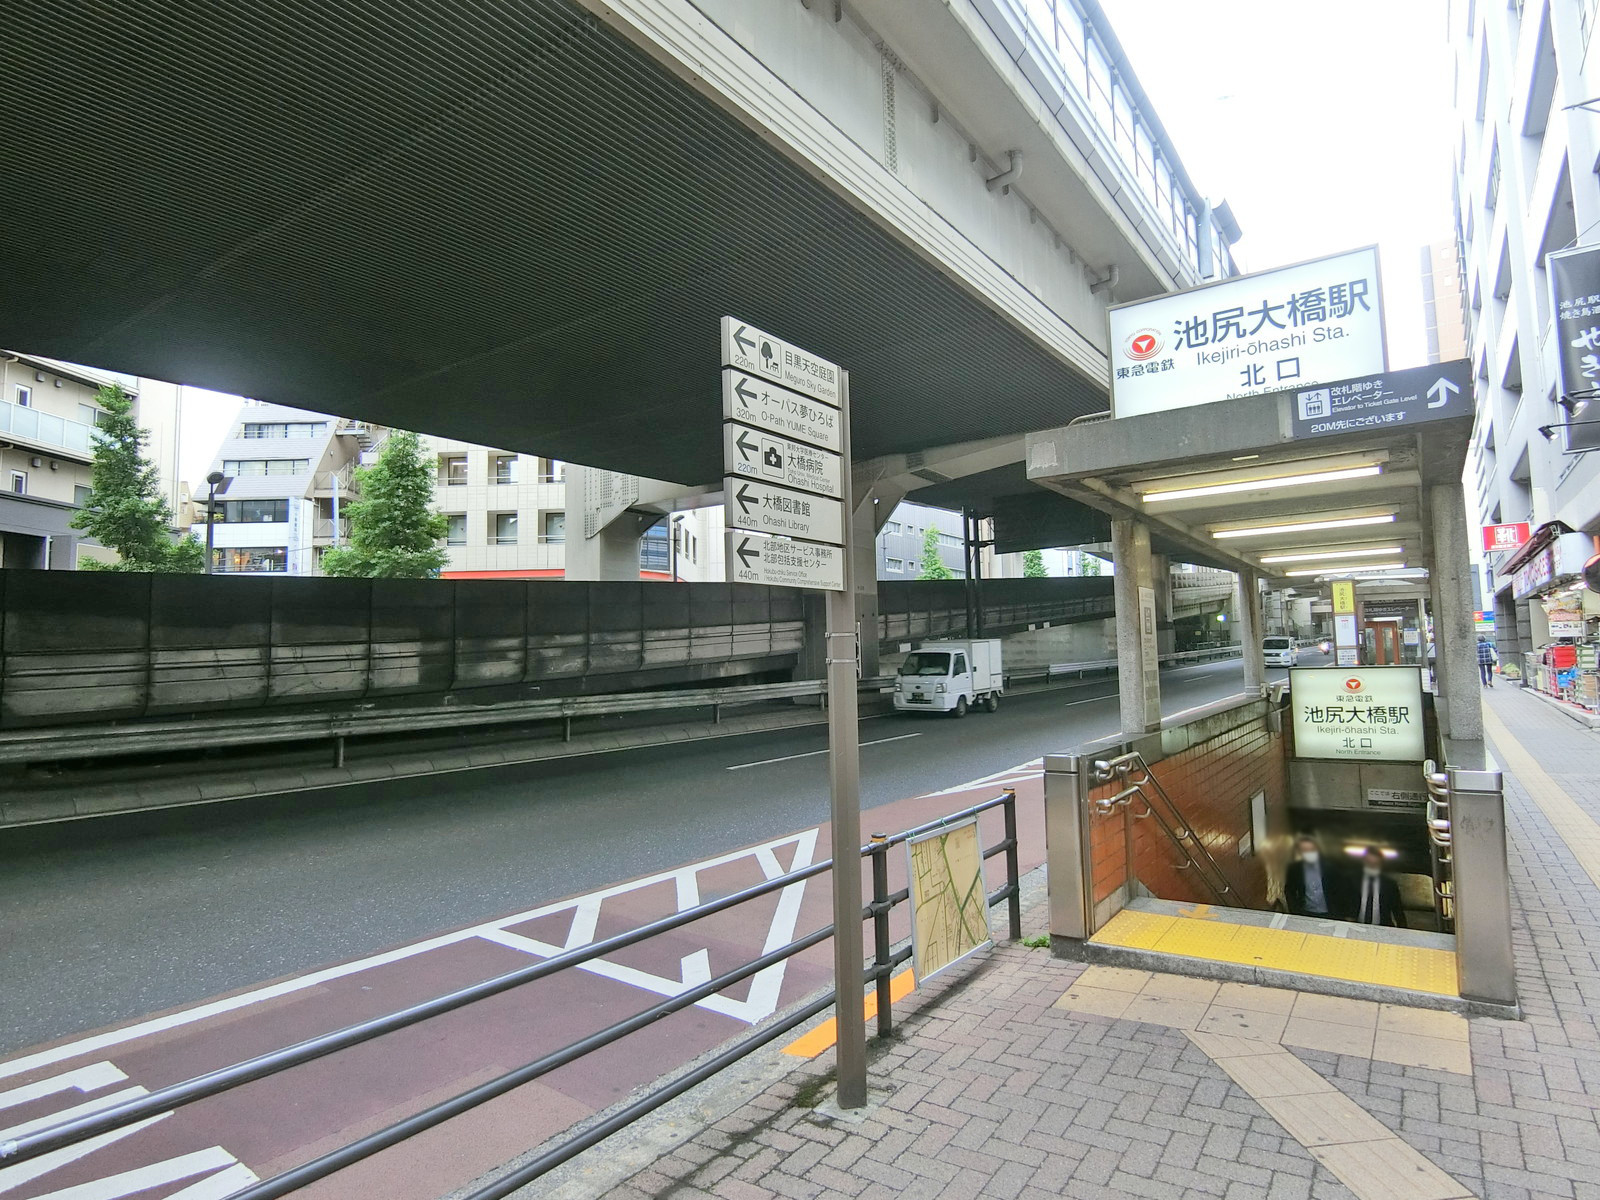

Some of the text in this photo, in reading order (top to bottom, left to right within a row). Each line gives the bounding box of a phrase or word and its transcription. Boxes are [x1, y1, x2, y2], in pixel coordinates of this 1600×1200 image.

[1173, 278, 1371, 351] 池尻大橋駅
[1313, 326, 1350, 343] Sta.
[734, 354, 755, 370] 220m
[785, 350, 835, 384] 目黒天空庭園
[1116, 358, 1175, 380] 東急電鉄
[1240, 357, 1300, 387] 北口
[785, 370, 836, 398] Meguro Sky Garden
[1330, 380, 1383, 396] 改札階ゆき
[1332, 390, 1394, 406] エレベーター
[1332, 405, 1357, 413] Elevator
[1383, 397, 1399, 405] Gate
[1400, 394, 1418, 402] Level
[736, 408, 757, 423] 320m
[761, 391, 834, 428] オーパス夢ひろば
[787, 419, 806, 435] YUME
[807, 426, 829, 442] Square
[1311, 411, 1406, 433] 20M先にございます
[737, 461, 758, 475] 220m
[787, 452, 824, 475] 大橋病院
[787, 473, 835, 494] Ohashi Hospital
[762, 492, 811, 517] 大橋図書館
[737, 515, 758, 528] 440m
[762, 514, 810, 534] Ohashi Library
[763, 540, 833, 560] 北部地区サービス事務所
[763, 553, 827, 569] 北部包括支援センター
[738, 570, 759, 581] 440m
[1336, 694, 1374, 703] 東急電鉄
[1304, 705, 1410, 725] 池尻大橋駅
[1379, 726, 1399, 735] Sta.
[1342, 737, 1373, 749] 北口
